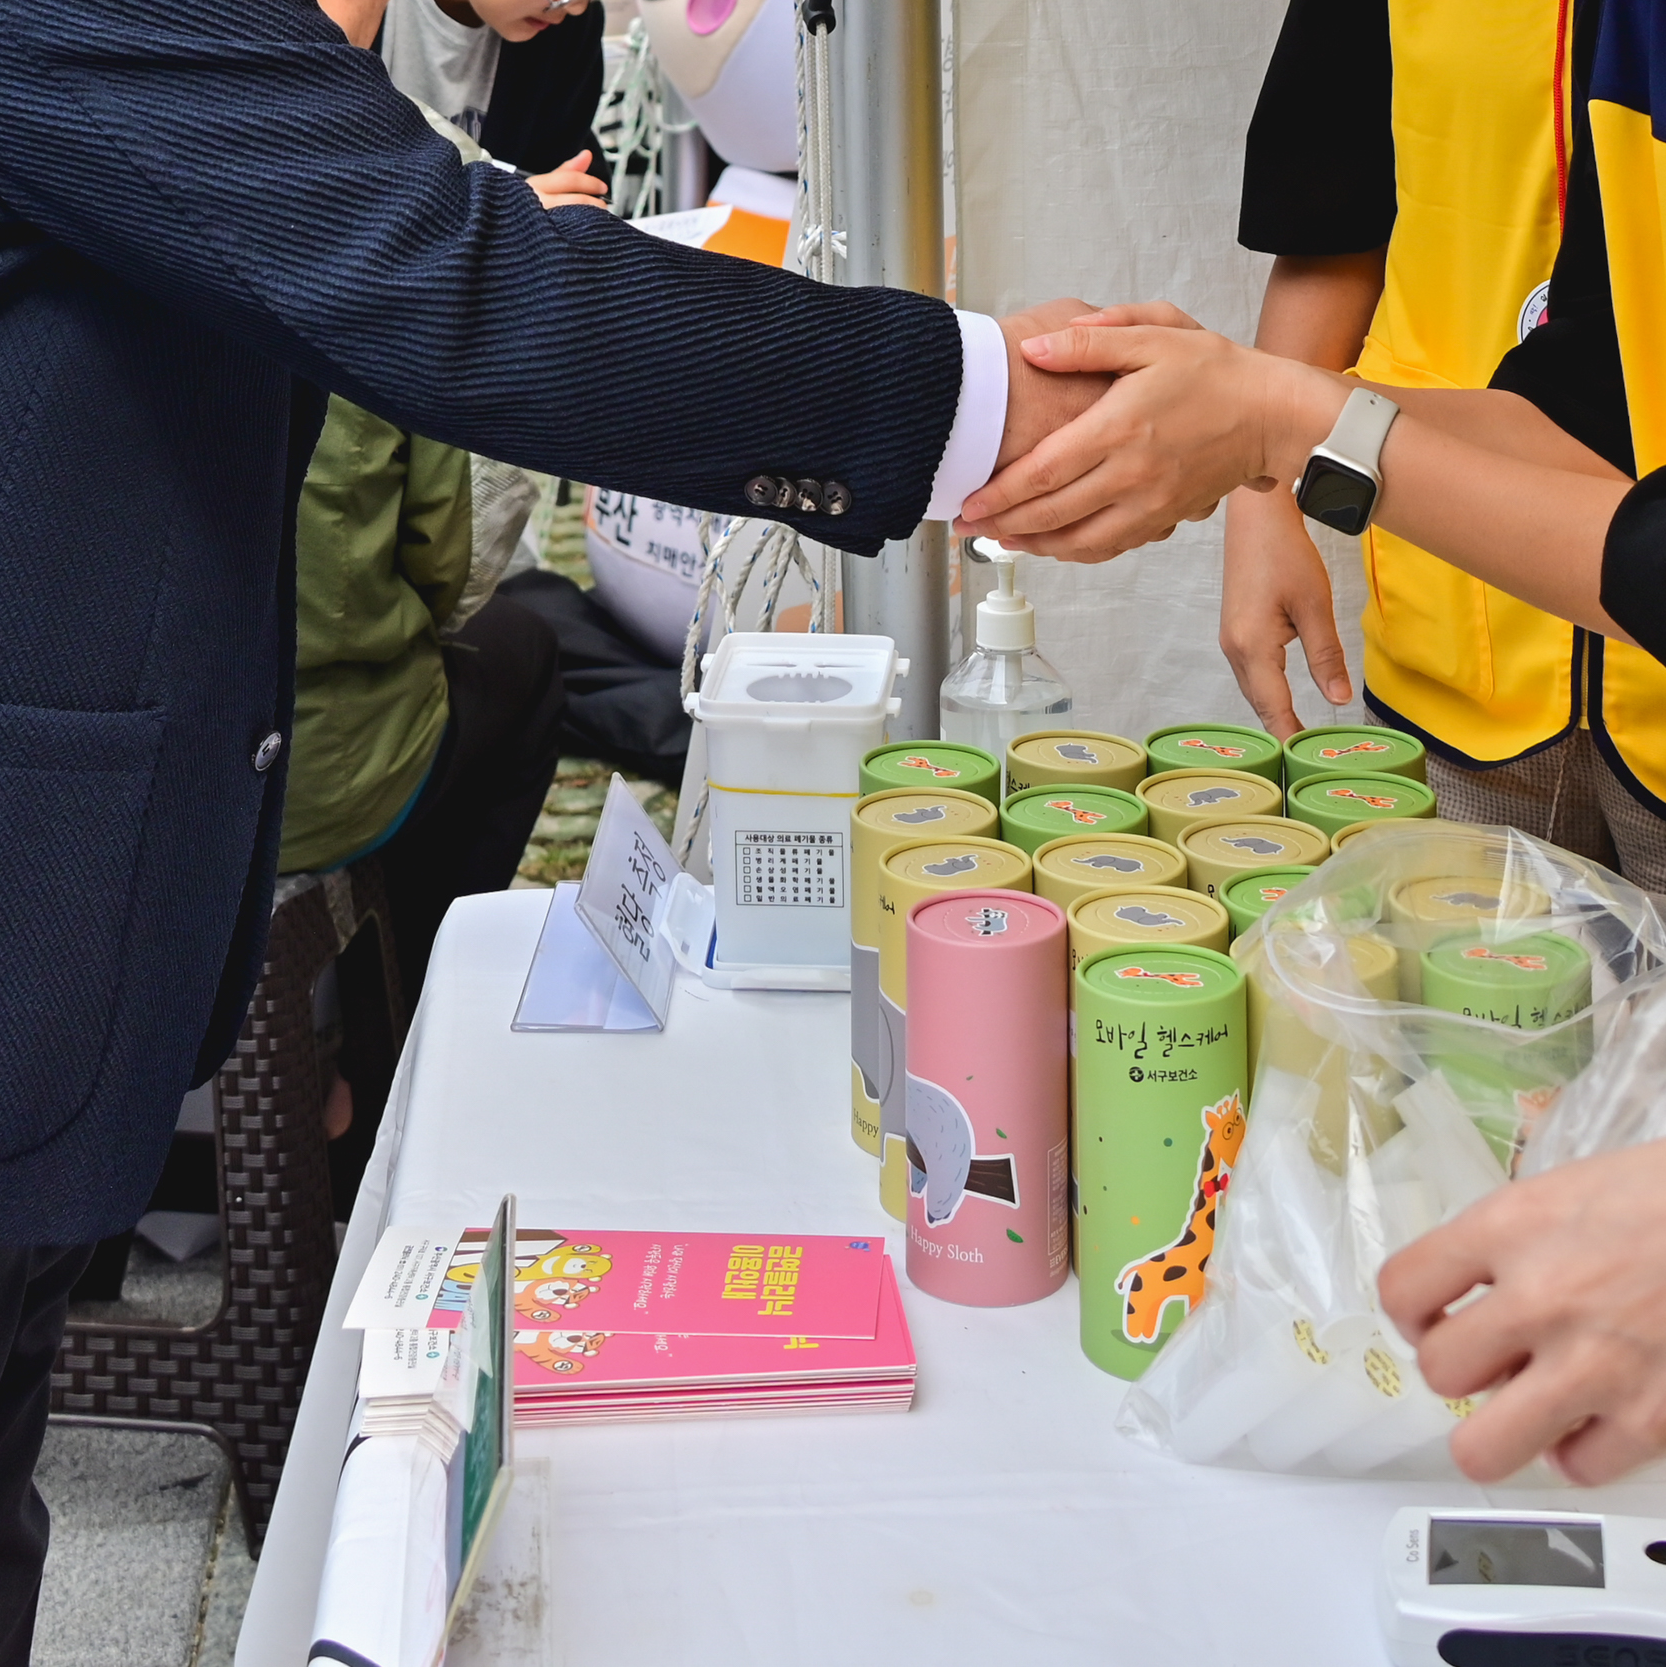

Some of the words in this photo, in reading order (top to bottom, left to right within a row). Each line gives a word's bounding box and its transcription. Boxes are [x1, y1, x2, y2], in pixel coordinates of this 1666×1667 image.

[777, 835, 792, 843] 의료
[819, 835, 833, 844] 종류
[1095, 1019, 1148, 1059] 모바일
[1156, 1025, 1229, 1058] 헬스케어
[1147, 1068, 1198, 1083] 서구보건소
[853, 1107, 879, 1138] Happy
[910, 1224, 943, 1258] Happy
[947, 1244, 984, 1264] Sloth
[721, 1244, 765, 1300] 이용안내
[757, 1245, 803, 1316] 금연클리닉
